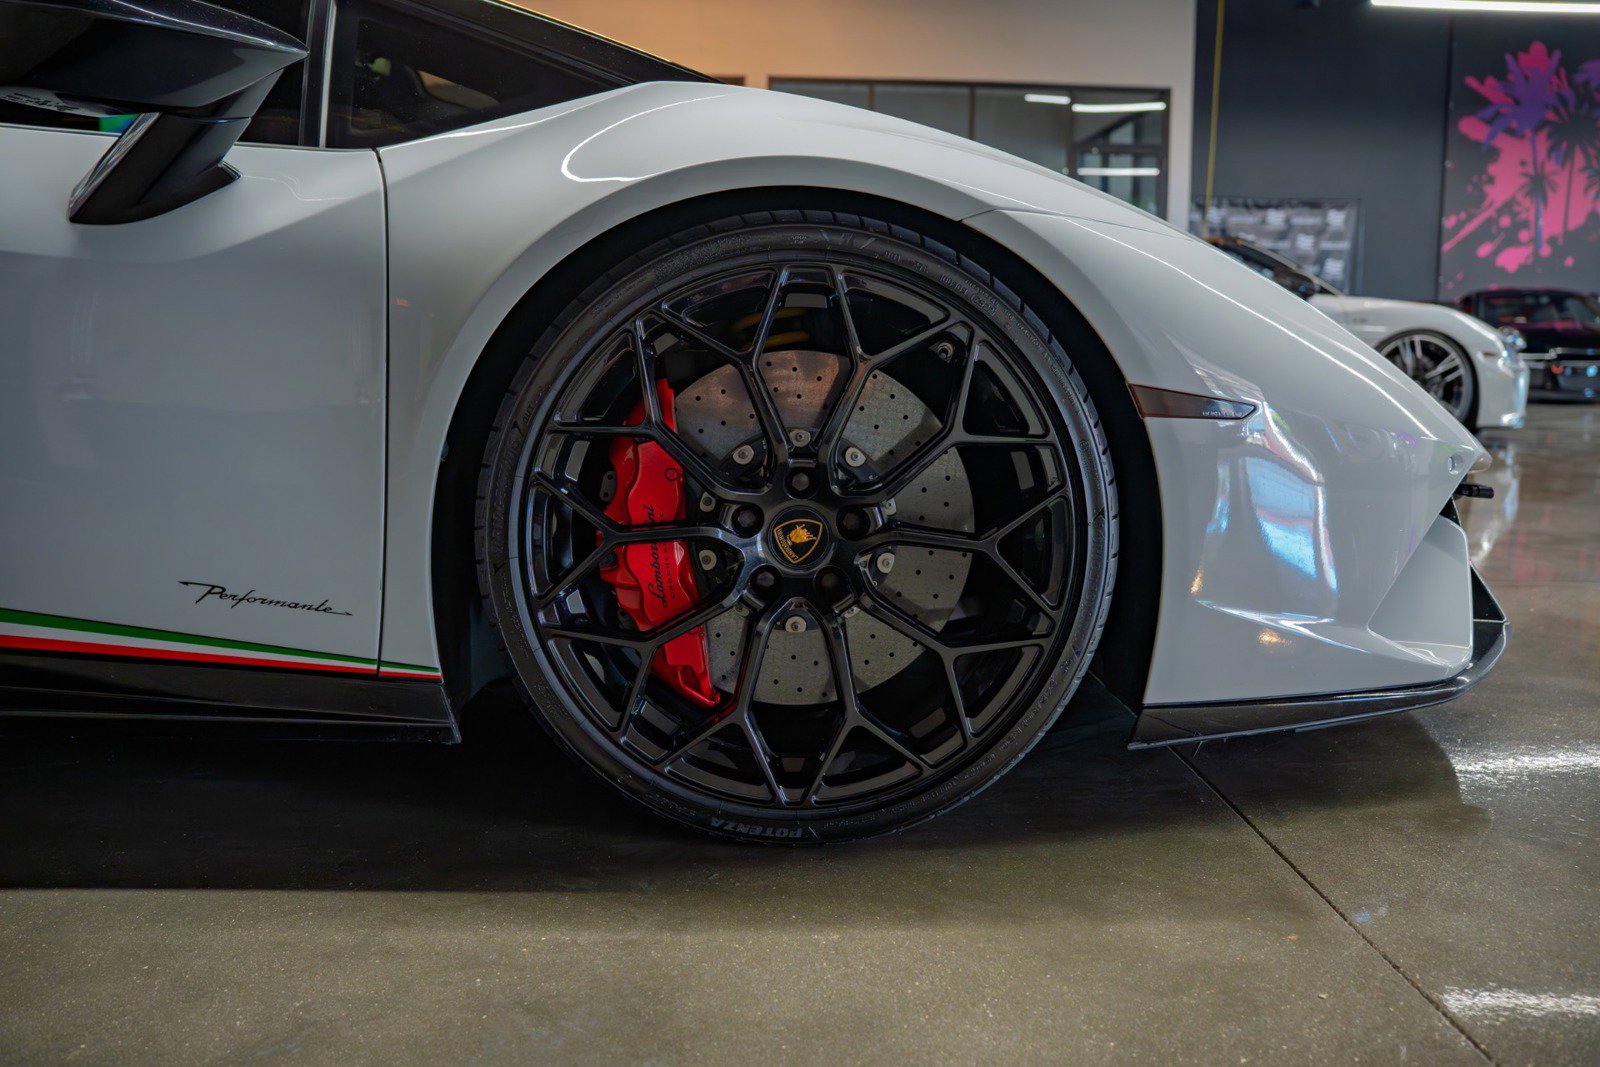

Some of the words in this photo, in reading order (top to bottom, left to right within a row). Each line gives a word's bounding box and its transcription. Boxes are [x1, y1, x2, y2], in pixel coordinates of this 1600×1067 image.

[643, 504, 667, 608] Lamborni
[177, 580, 354, 617] Performante
[711, 816, 803, 838] POTENZA
